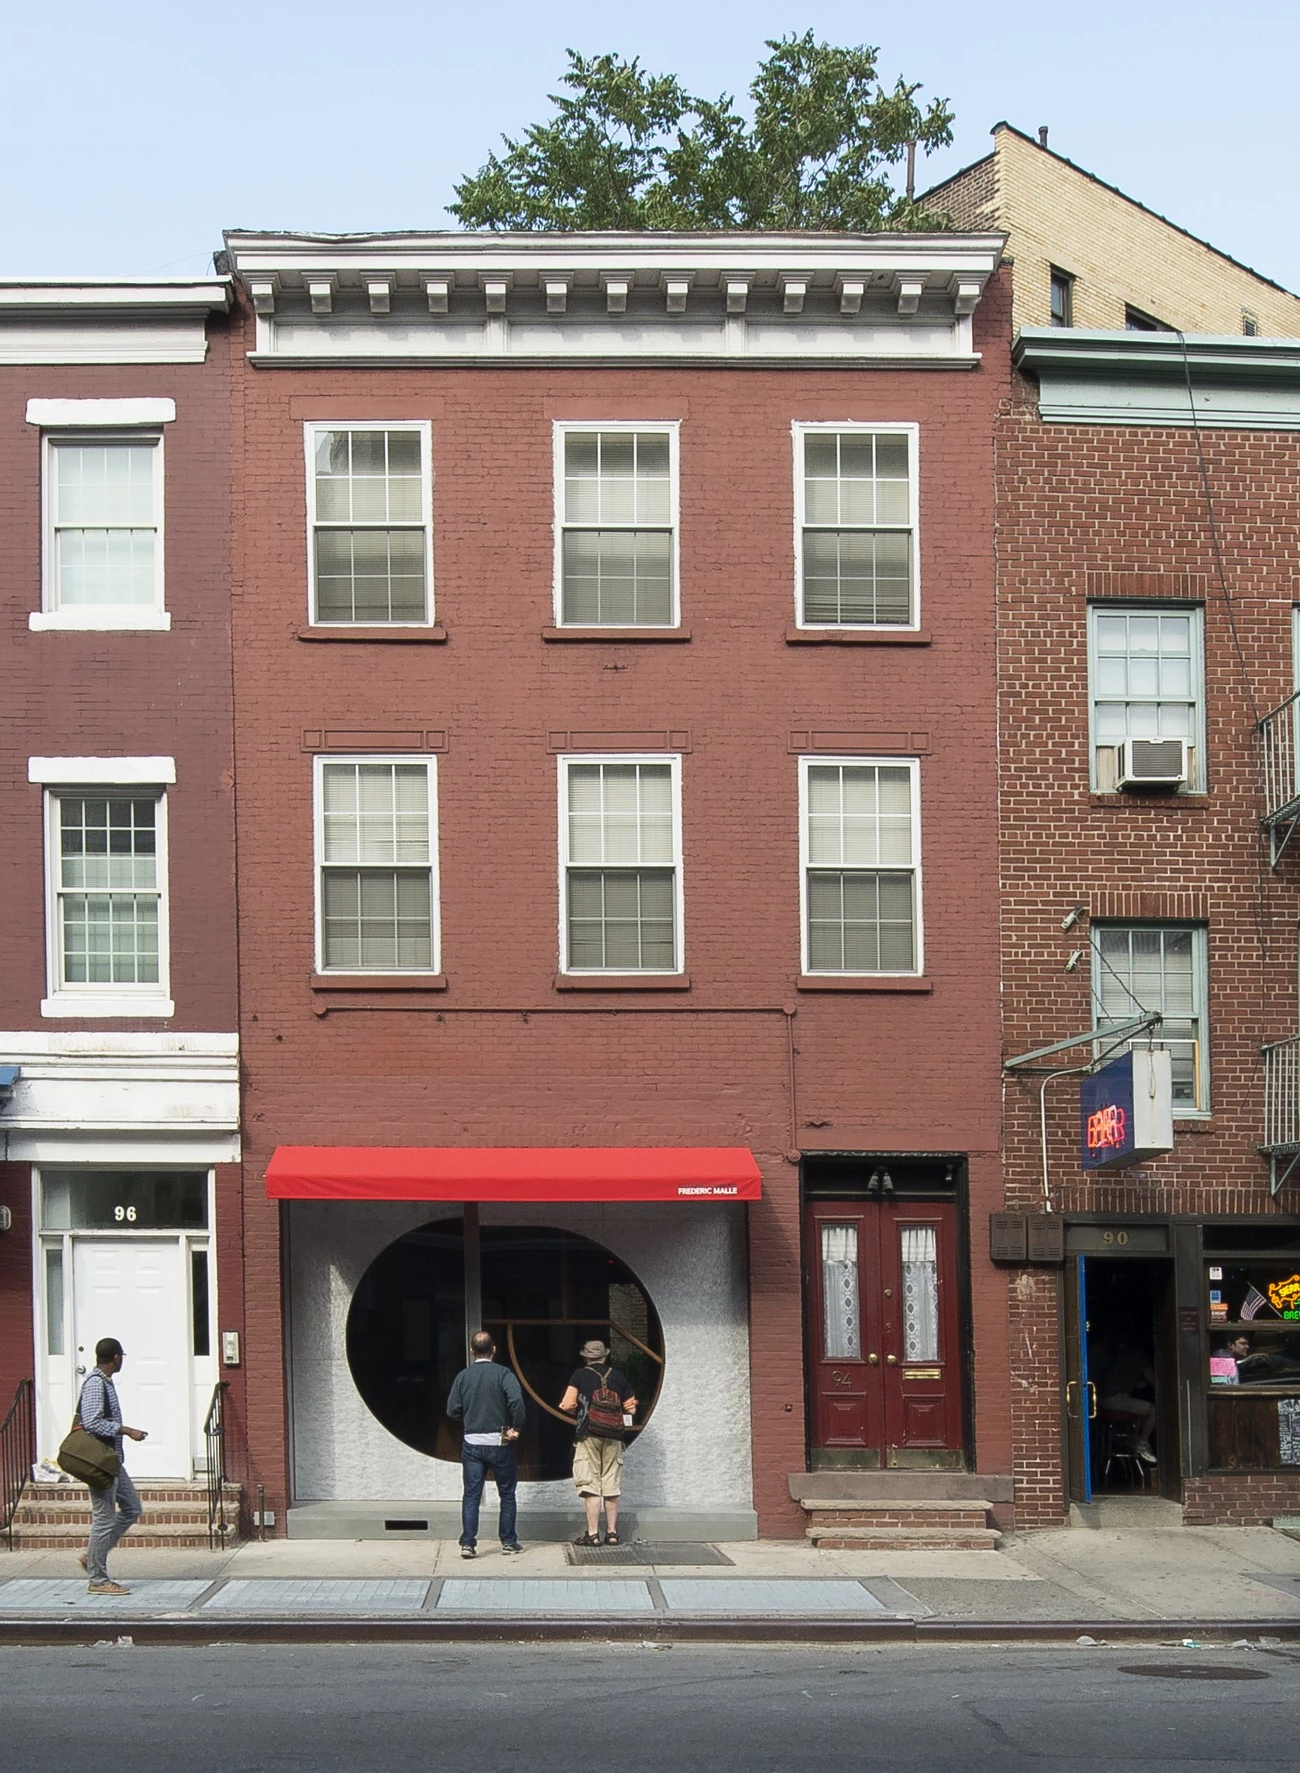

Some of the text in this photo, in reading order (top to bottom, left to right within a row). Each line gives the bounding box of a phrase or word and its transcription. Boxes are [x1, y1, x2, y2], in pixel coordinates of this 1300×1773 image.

[678, 1187, 738, 1195] FREDERIC MALLE
[114, 1205, 137, 1221] 96
[1102, 1231, 1129, 1246] 90
[831, 1370, 853, 1388] 94
